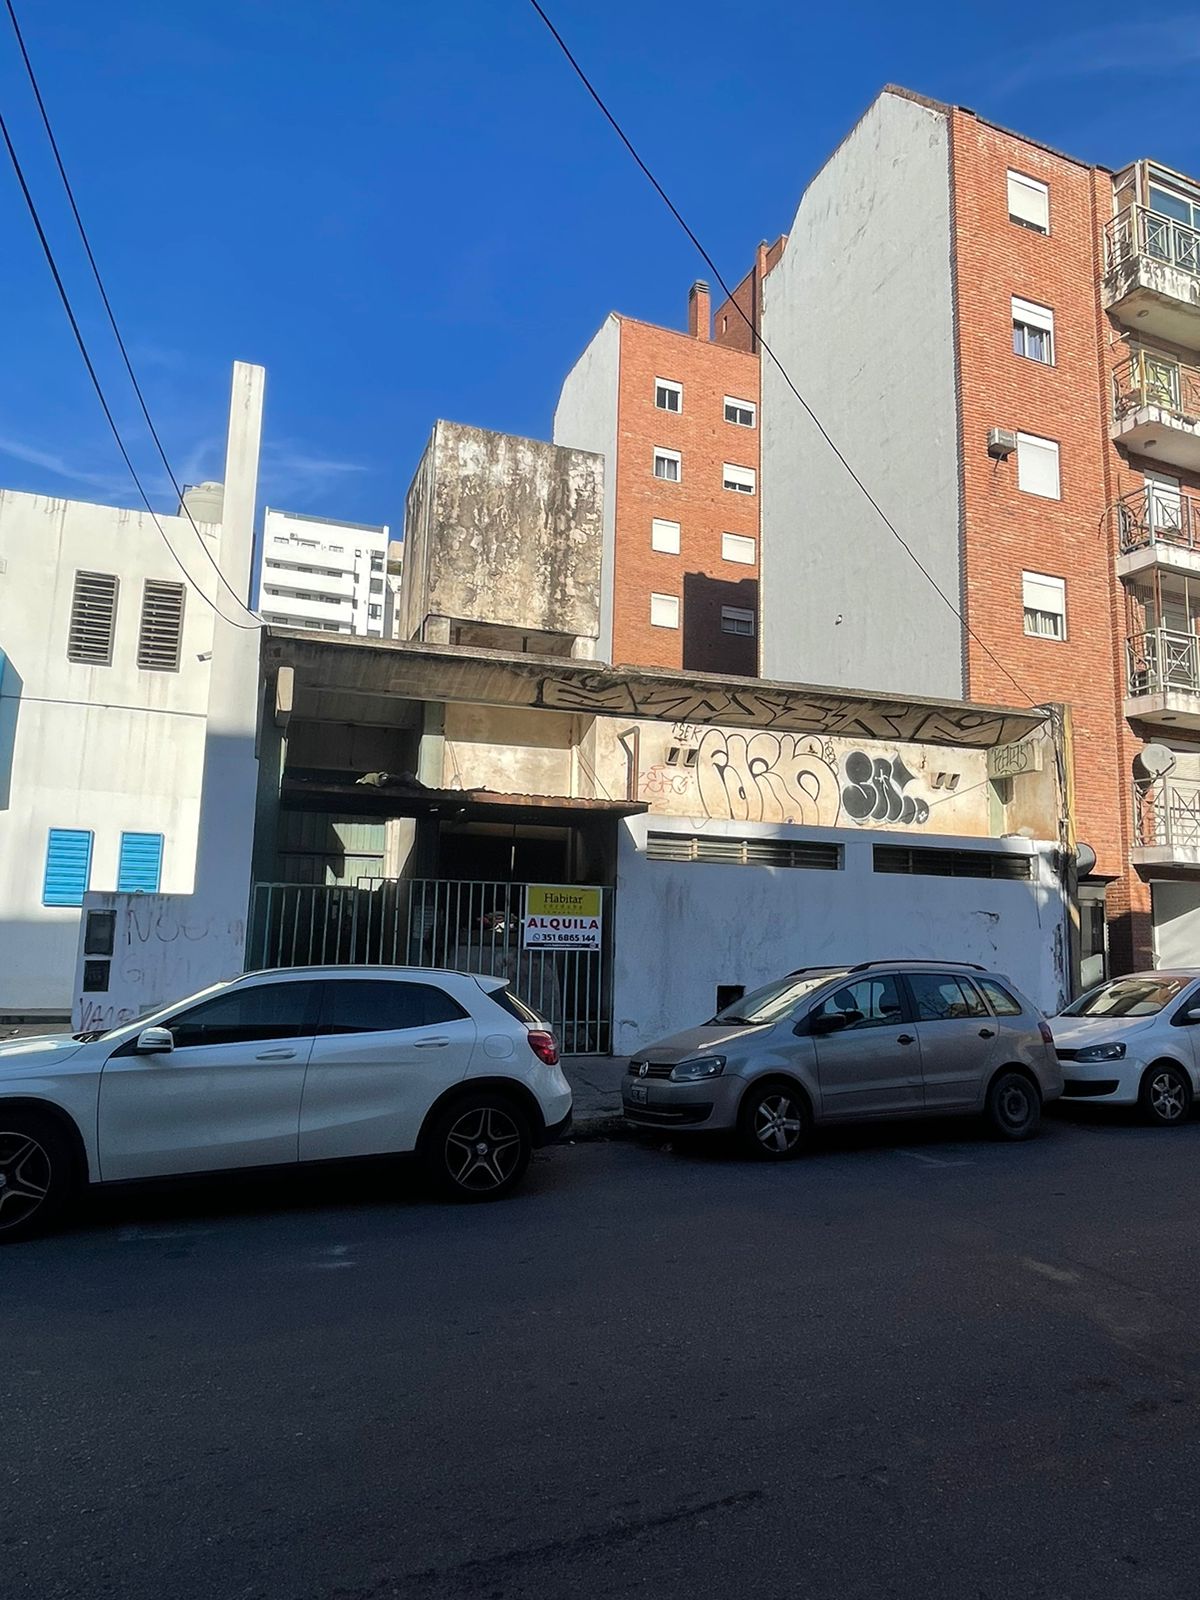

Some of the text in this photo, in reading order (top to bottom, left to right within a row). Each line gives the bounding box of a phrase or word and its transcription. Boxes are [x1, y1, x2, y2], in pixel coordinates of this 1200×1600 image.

[544, 892, 583, 904] Habitar
[527, 917, 599, 931] ALQUILA
[542, 933, 596, 942] 351 6865 144
